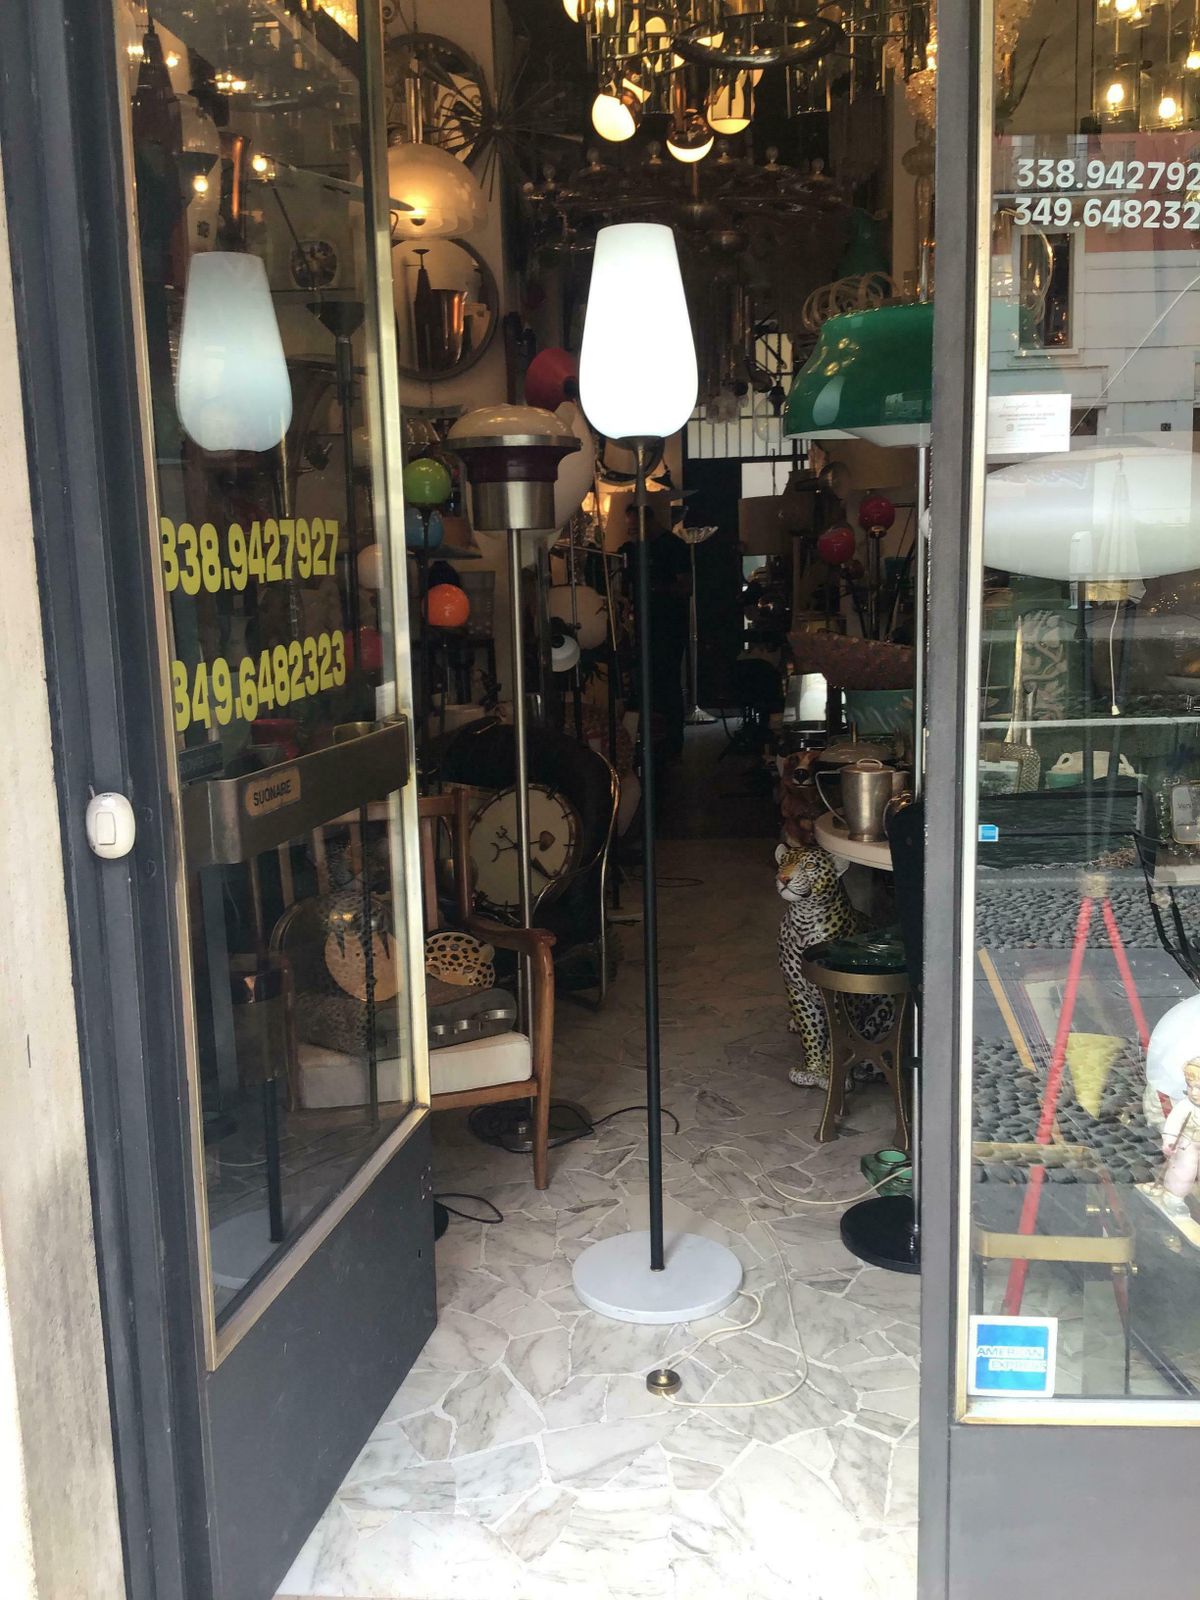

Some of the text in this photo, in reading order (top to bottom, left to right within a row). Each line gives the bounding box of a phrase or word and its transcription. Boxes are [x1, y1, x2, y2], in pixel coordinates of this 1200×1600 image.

[160, 516, 339, 596] 338.9427927
[172, 630, 347, 732] 349.6482323
[253, 779, 292, 807] SUONARE
